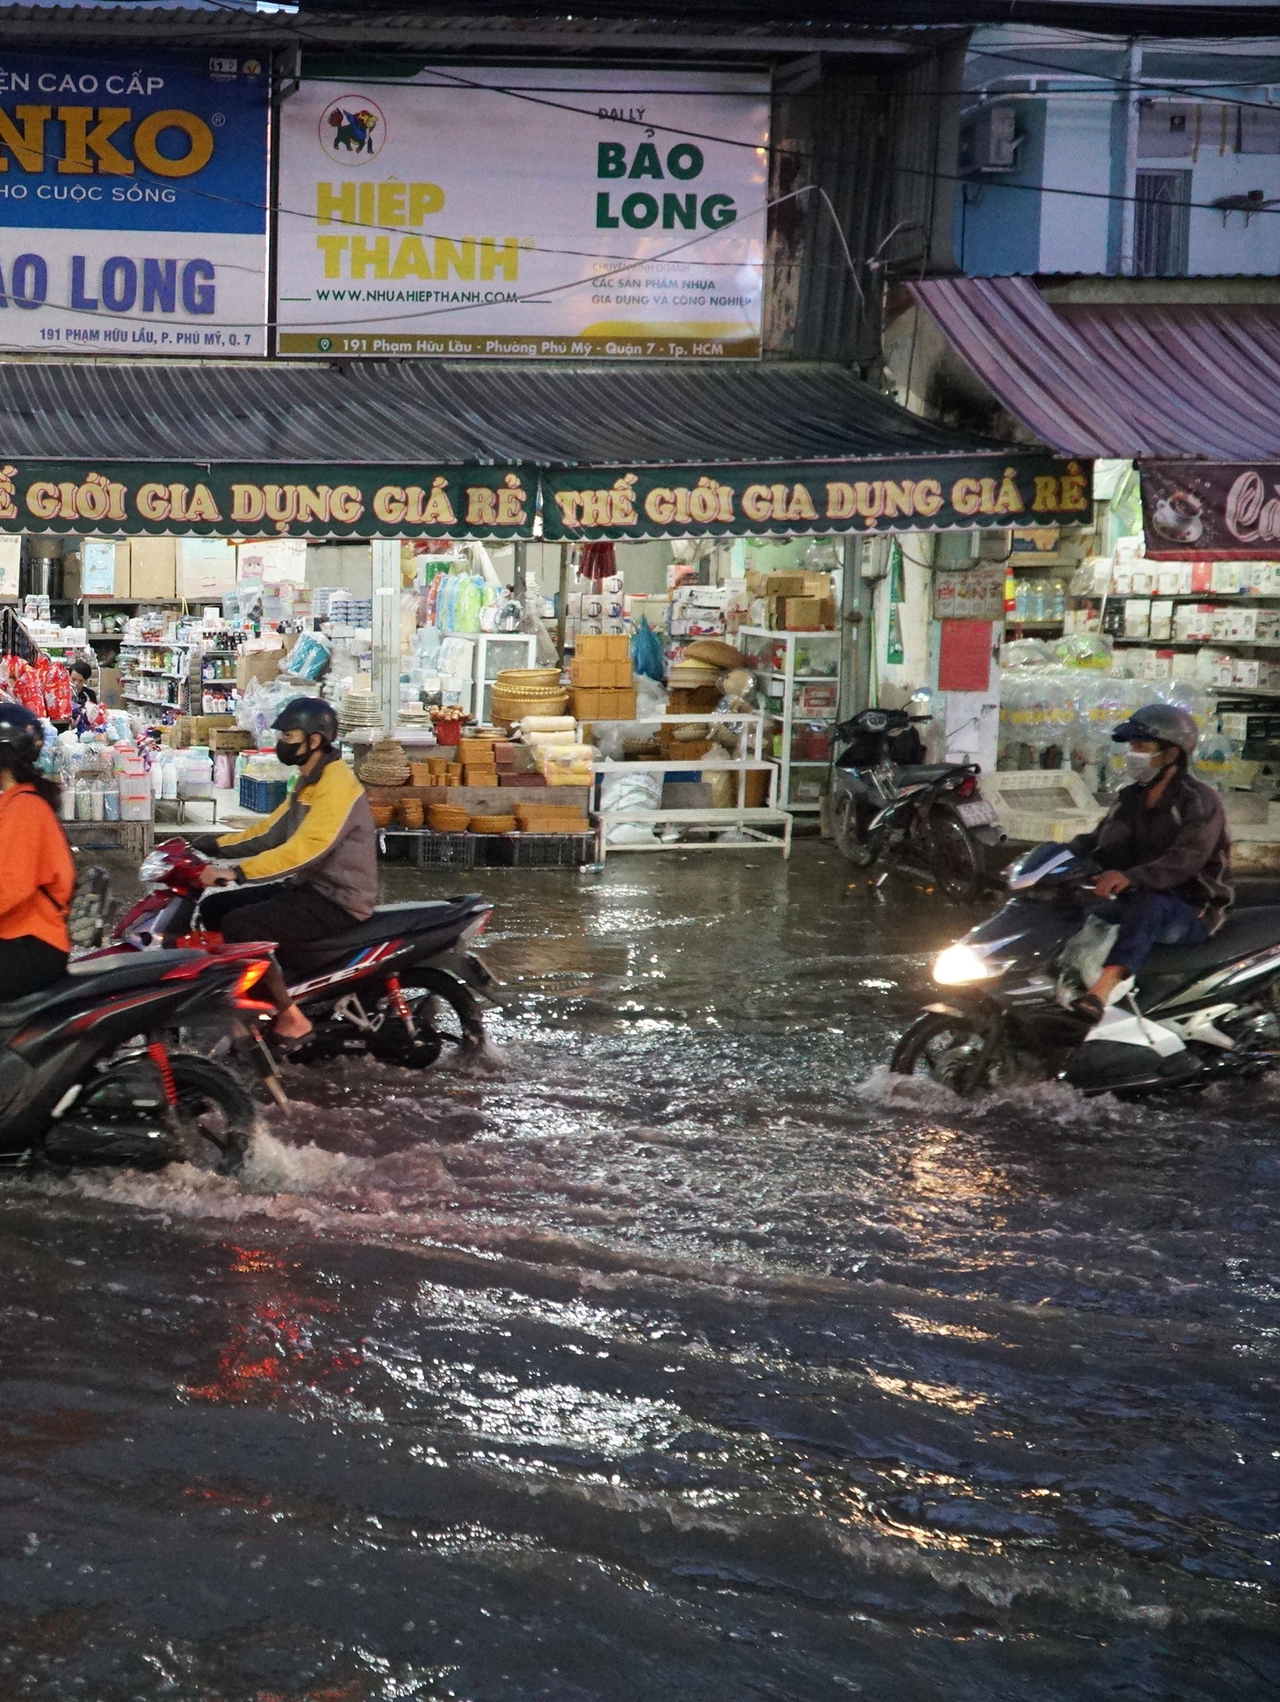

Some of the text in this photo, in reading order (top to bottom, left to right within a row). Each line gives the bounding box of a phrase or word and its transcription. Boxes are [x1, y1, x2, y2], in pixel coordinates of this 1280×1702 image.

[37, 73, 99, 93] CAO
[105, 68, 165, 97] CẤP
[629, 105, 646, 121] LÝ
[597, 129, 705, 180] BẢO
[36, 183, 103, 203] CUỘC
[112, 181, 177, 204] SỐNG
[317, 175, 445, 230] HIỆP
[595, 192, 738, 230] LONG
[71, 255, 216, 316] LONG
[317, 290, 519, 303] WWW.NHUAHIEPTHANH.COM
[592, 277, 614, 288] CÁC
[682, 279, 716, 292] NHỰA
[592, 294, 612, 305] GIA
[616, 294, 649, 307] DỤNG
[653, 293, 669, 305] VÀ
[672, 293, 707, 306] CÔNG
[39, 326, 252, 347] 191 PHẠM HỮU LẦU, P. PHÚ MỸ, Q. 7
[342, 340, 368, 352] 191
[373, 339, 416, 356] Phạm
[419, 339, 445, 354] Hữu
[448, 338, 474, 354] Lầu
[485, 340, 537, 358] Phường
[541, 340, 567, 355] Phú
[570, 340, 593, 359] Mỹ
[605, 341, 642, 359] Quận
[645, 342, 655, 355] 7
[668, 343, 687, 359] Tp.
[691, 343, 724, 356] HCM
[25, 471, 129, 521] GIỚI
[135, 482, 223, 523] GIA
[231, 484, 366, 534] DỤNG
[373, 475, 459, 526] GIÁ
[465, 472, 528, 527] RẺ
[554, 461, 1088, 529] THẾ GIỚI GIA DỤNG GIÁ RẺ
